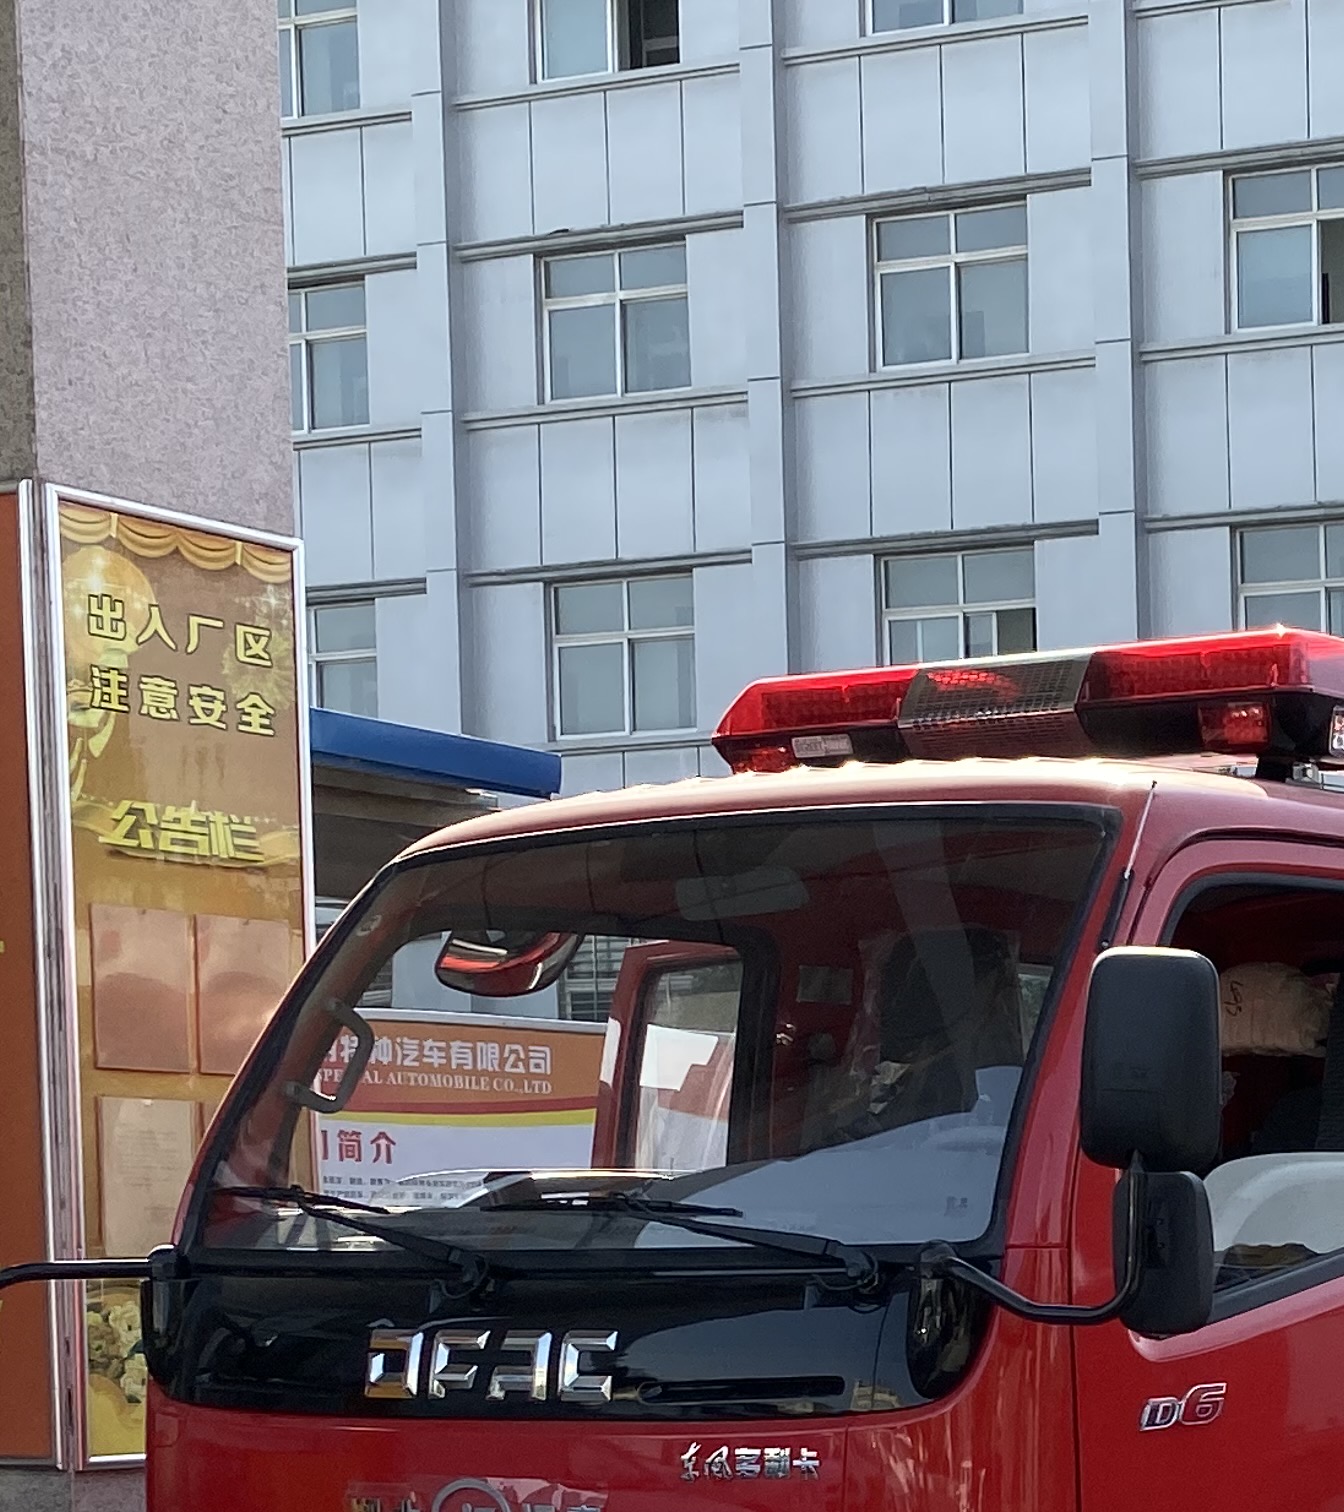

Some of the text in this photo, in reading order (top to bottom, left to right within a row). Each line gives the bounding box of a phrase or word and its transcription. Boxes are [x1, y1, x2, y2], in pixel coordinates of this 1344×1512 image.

[87, 593, 274, 668] 出入厂区
[89, 664, 276, 737] 注意安全
[98, 799, 265, 863] 公告栏
[386, 1071, 491, 1091] AUTOMOBILE
[364, 1329, 619, 1401] DFAC
[1139, 1383, 1227, 1432] D6
[680, 1441, 821, 1481] 东风多利卡
